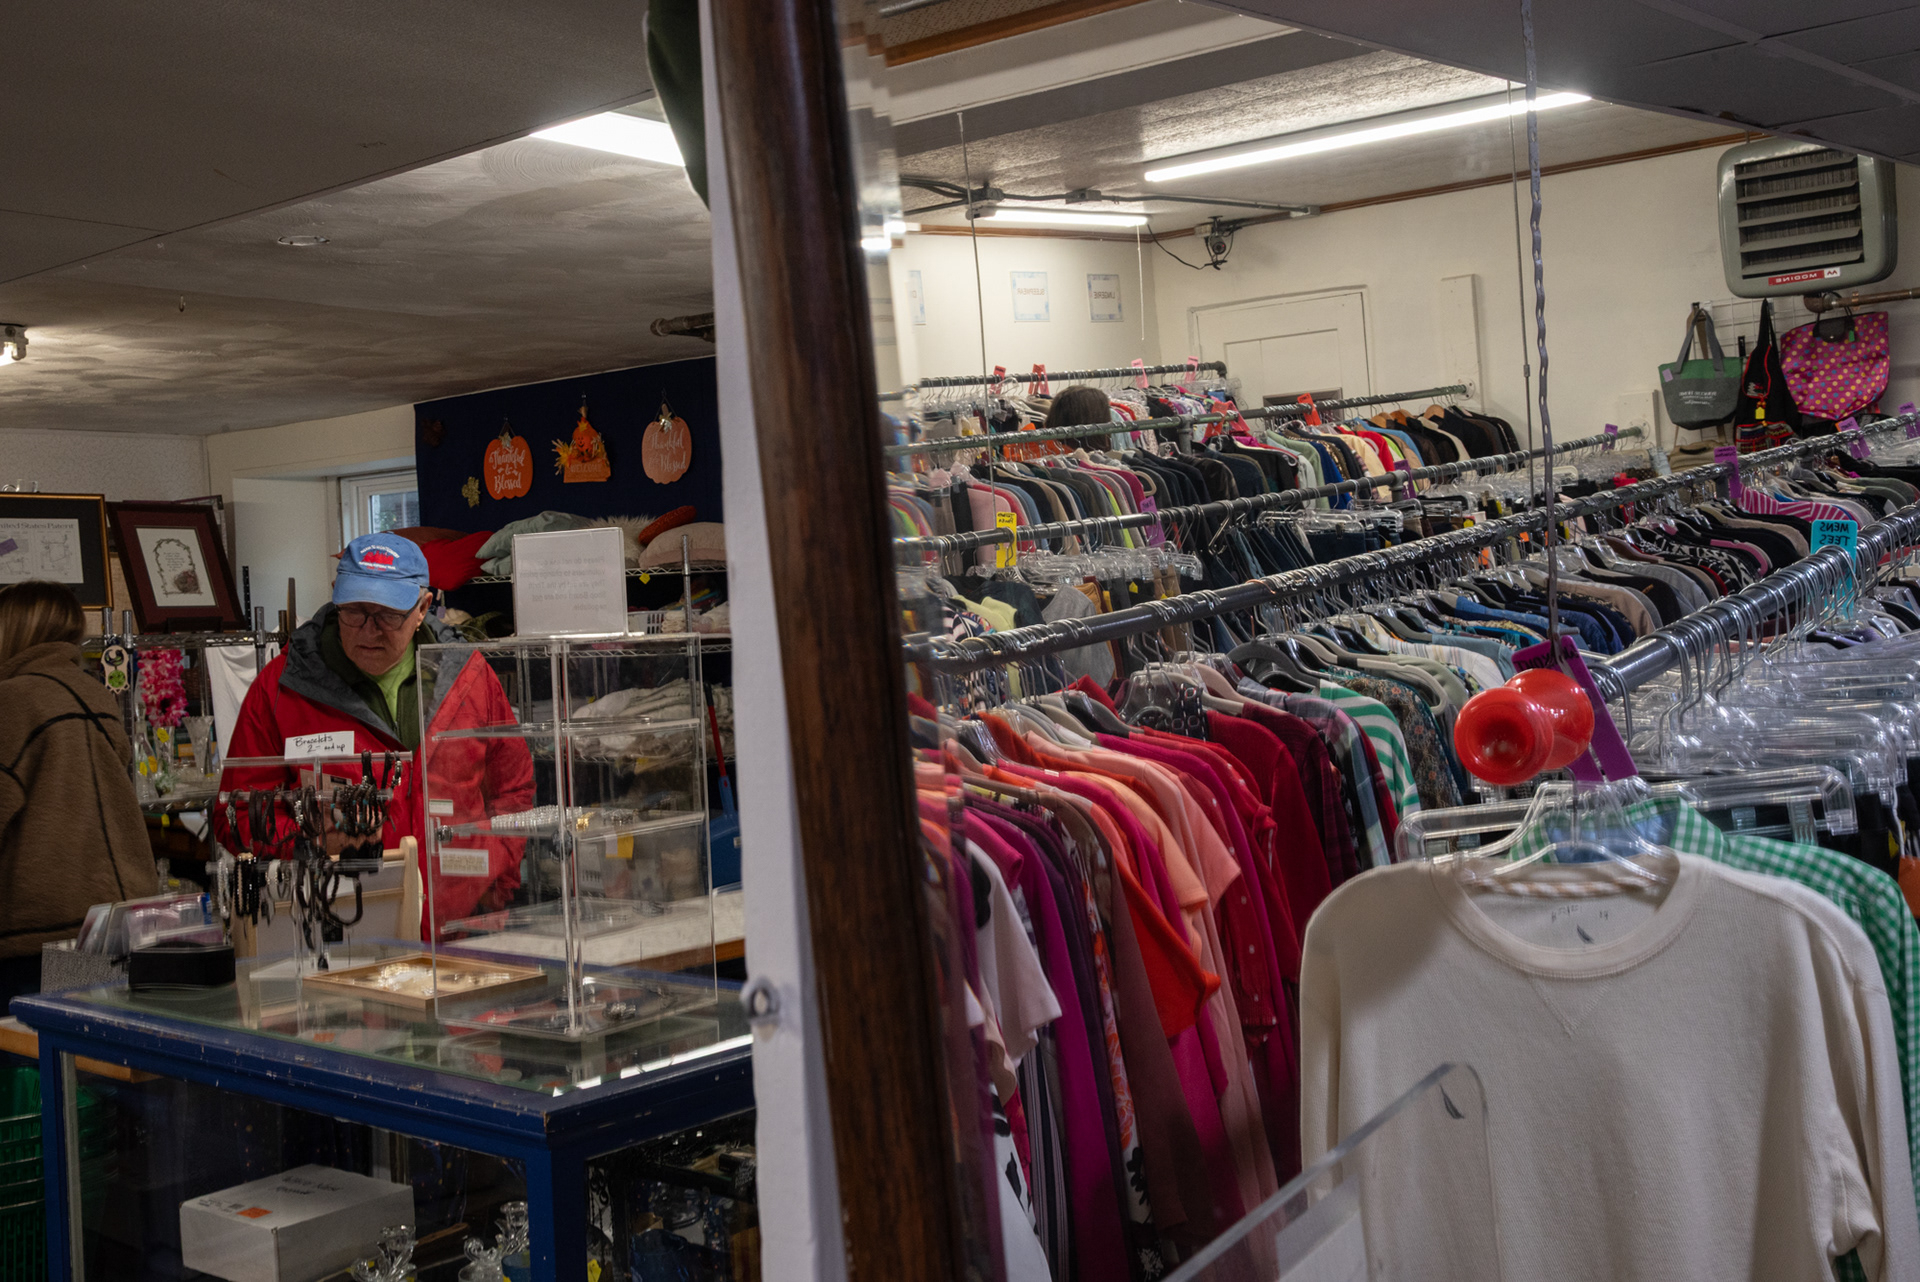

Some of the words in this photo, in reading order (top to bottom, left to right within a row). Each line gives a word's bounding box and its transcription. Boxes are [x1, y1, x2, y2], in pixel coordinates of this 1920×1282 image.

[489, 447, 525, 469] Thankful
[494, 472, 522, 494] Blessed
[293, 734, 333, 747] Bracelets
[336, 743, 346, 752] up
